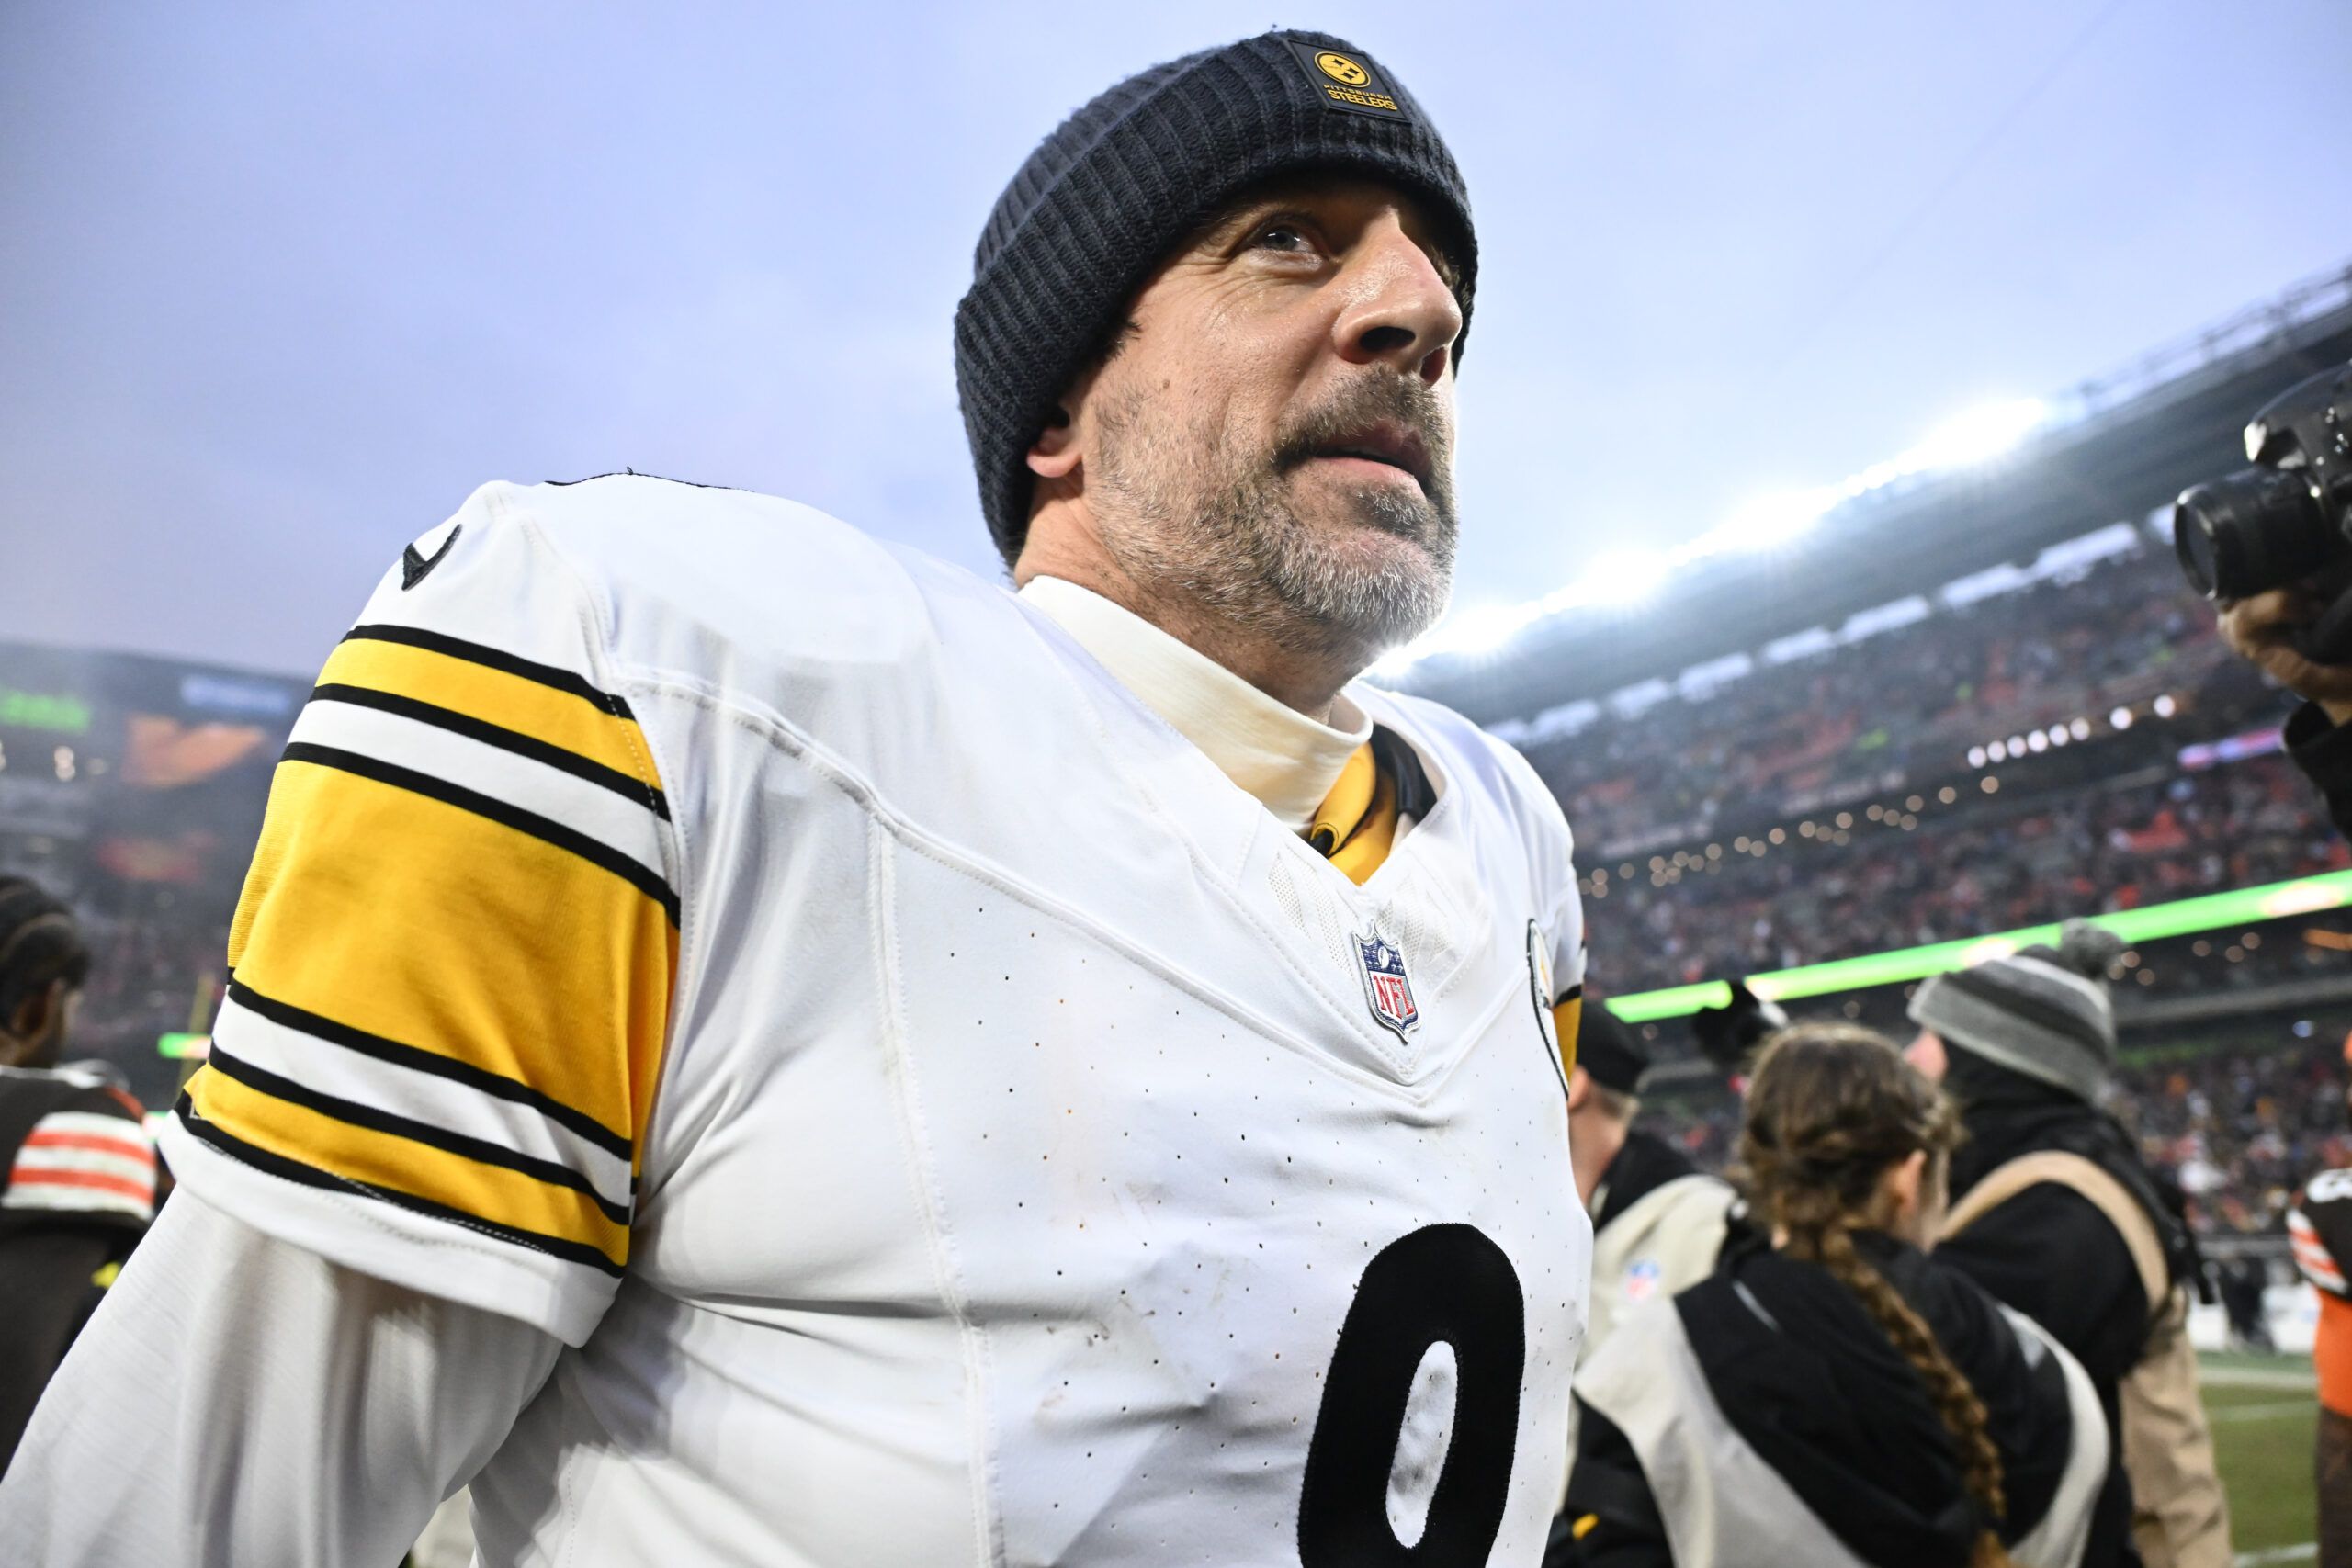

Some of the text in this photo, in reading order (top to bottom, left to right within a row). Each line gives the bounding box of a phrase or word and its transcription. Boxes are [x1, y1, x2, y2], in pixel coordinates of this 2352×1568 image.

[1323, 84, 1393, 100] PITTSBURGH
[1327, 89, 1397, 111] STEELERS
[1373, 974, 1415, 1020] NFL
